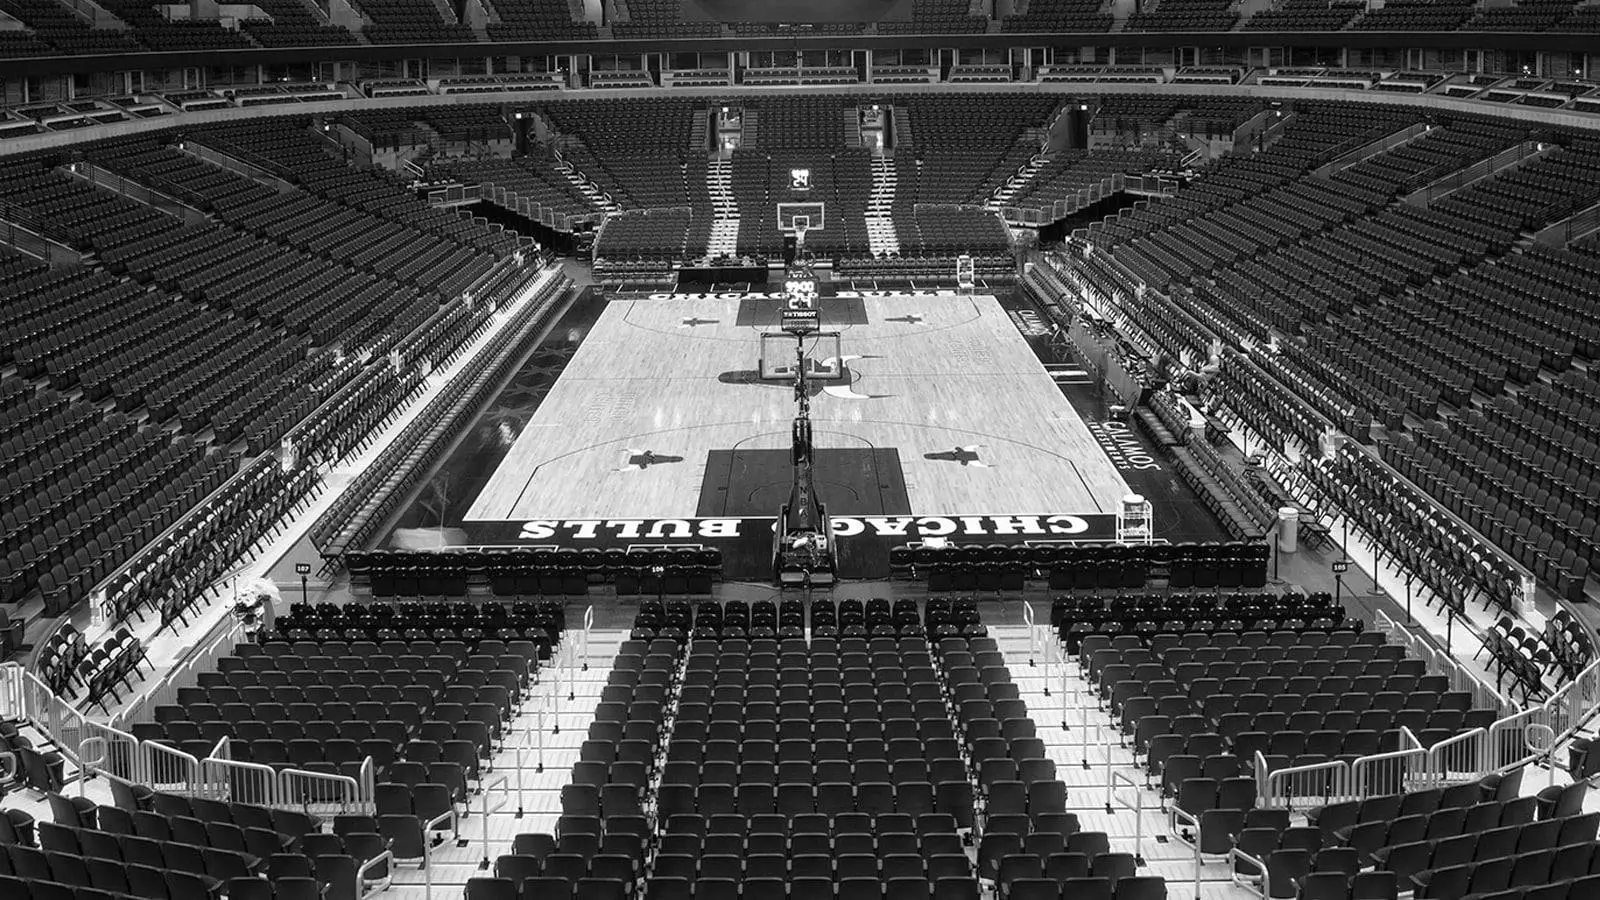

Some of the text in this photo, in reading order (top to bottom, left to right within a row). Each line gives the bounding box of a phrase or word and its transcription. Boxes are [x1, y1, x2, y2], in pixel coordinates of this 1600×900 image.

[1087, 421, 1131, 470] INVESTMENTS
[1102, 421, 1162, 470] CALAMOS
[518, 516, 1090, 540] BULLS CHICAG
